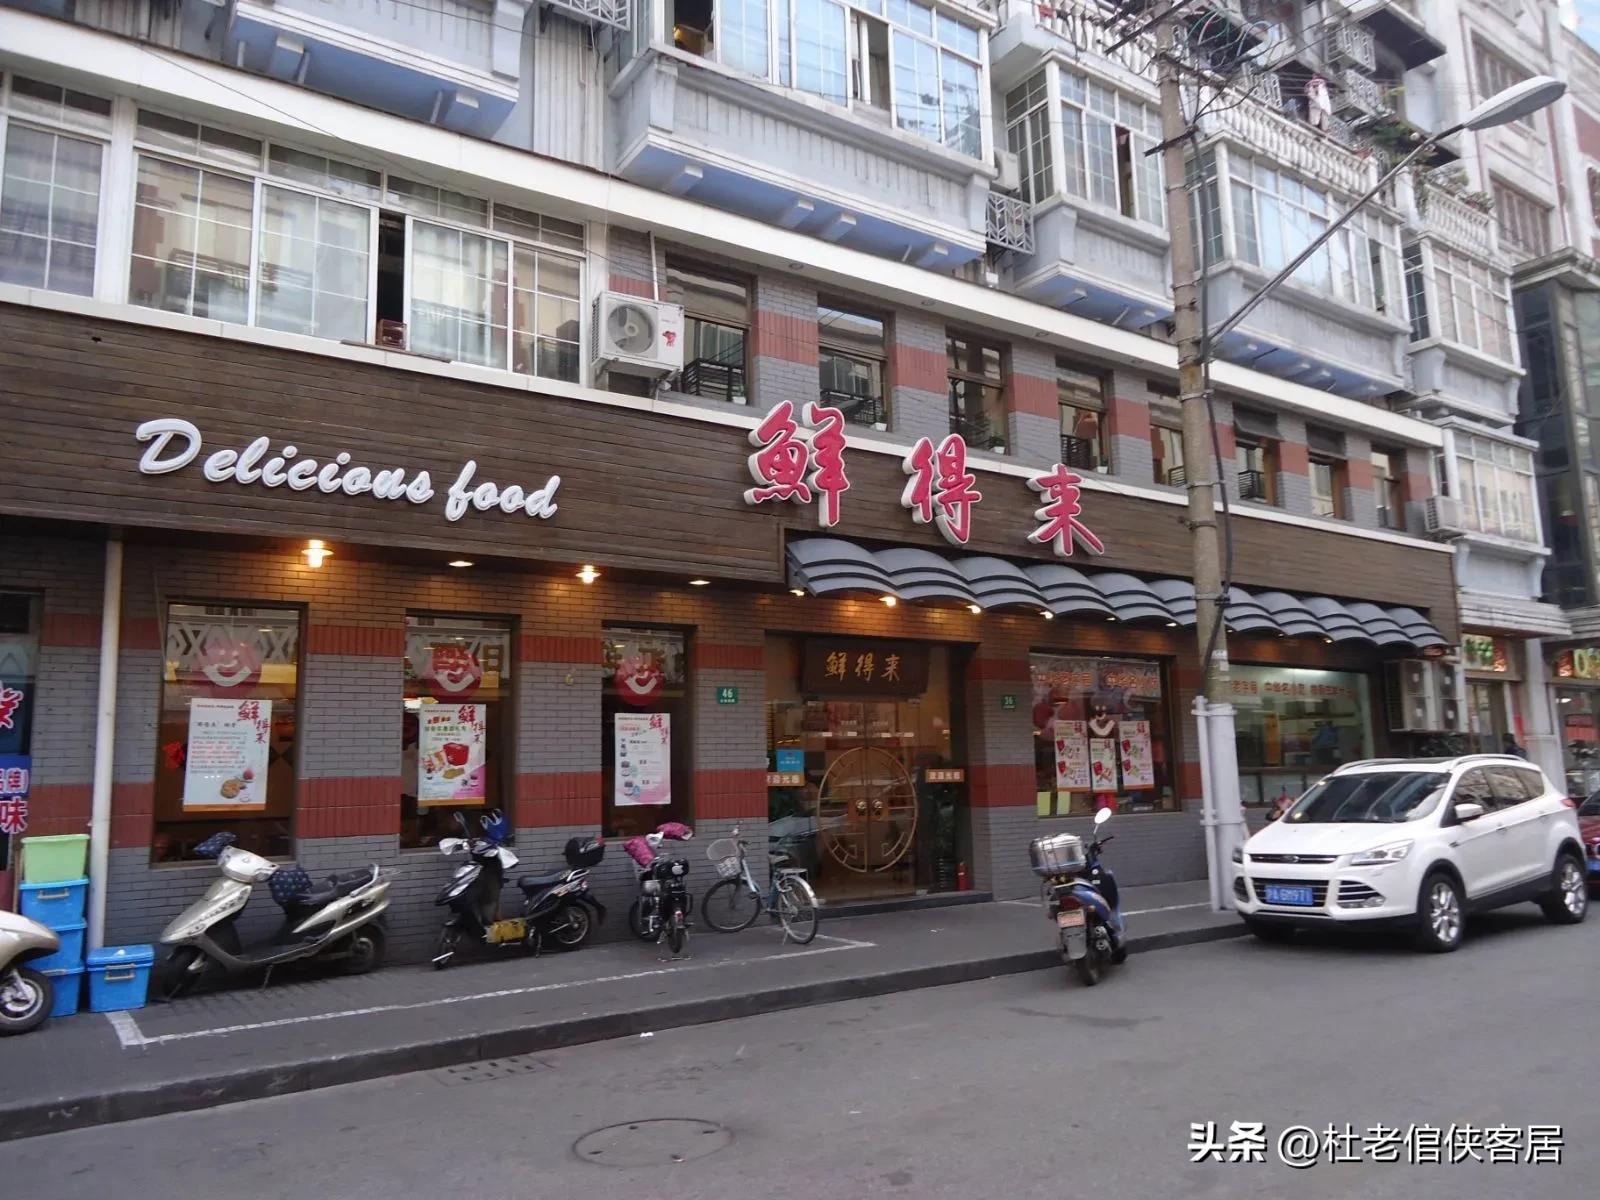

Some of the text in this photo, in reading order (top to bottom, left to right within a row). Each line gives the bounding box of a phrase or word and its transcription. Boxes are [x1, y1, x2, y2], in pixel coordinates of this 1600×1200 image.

[135, 417, 563, 523] Delicious food
[722, 688, 733, 698] 46
